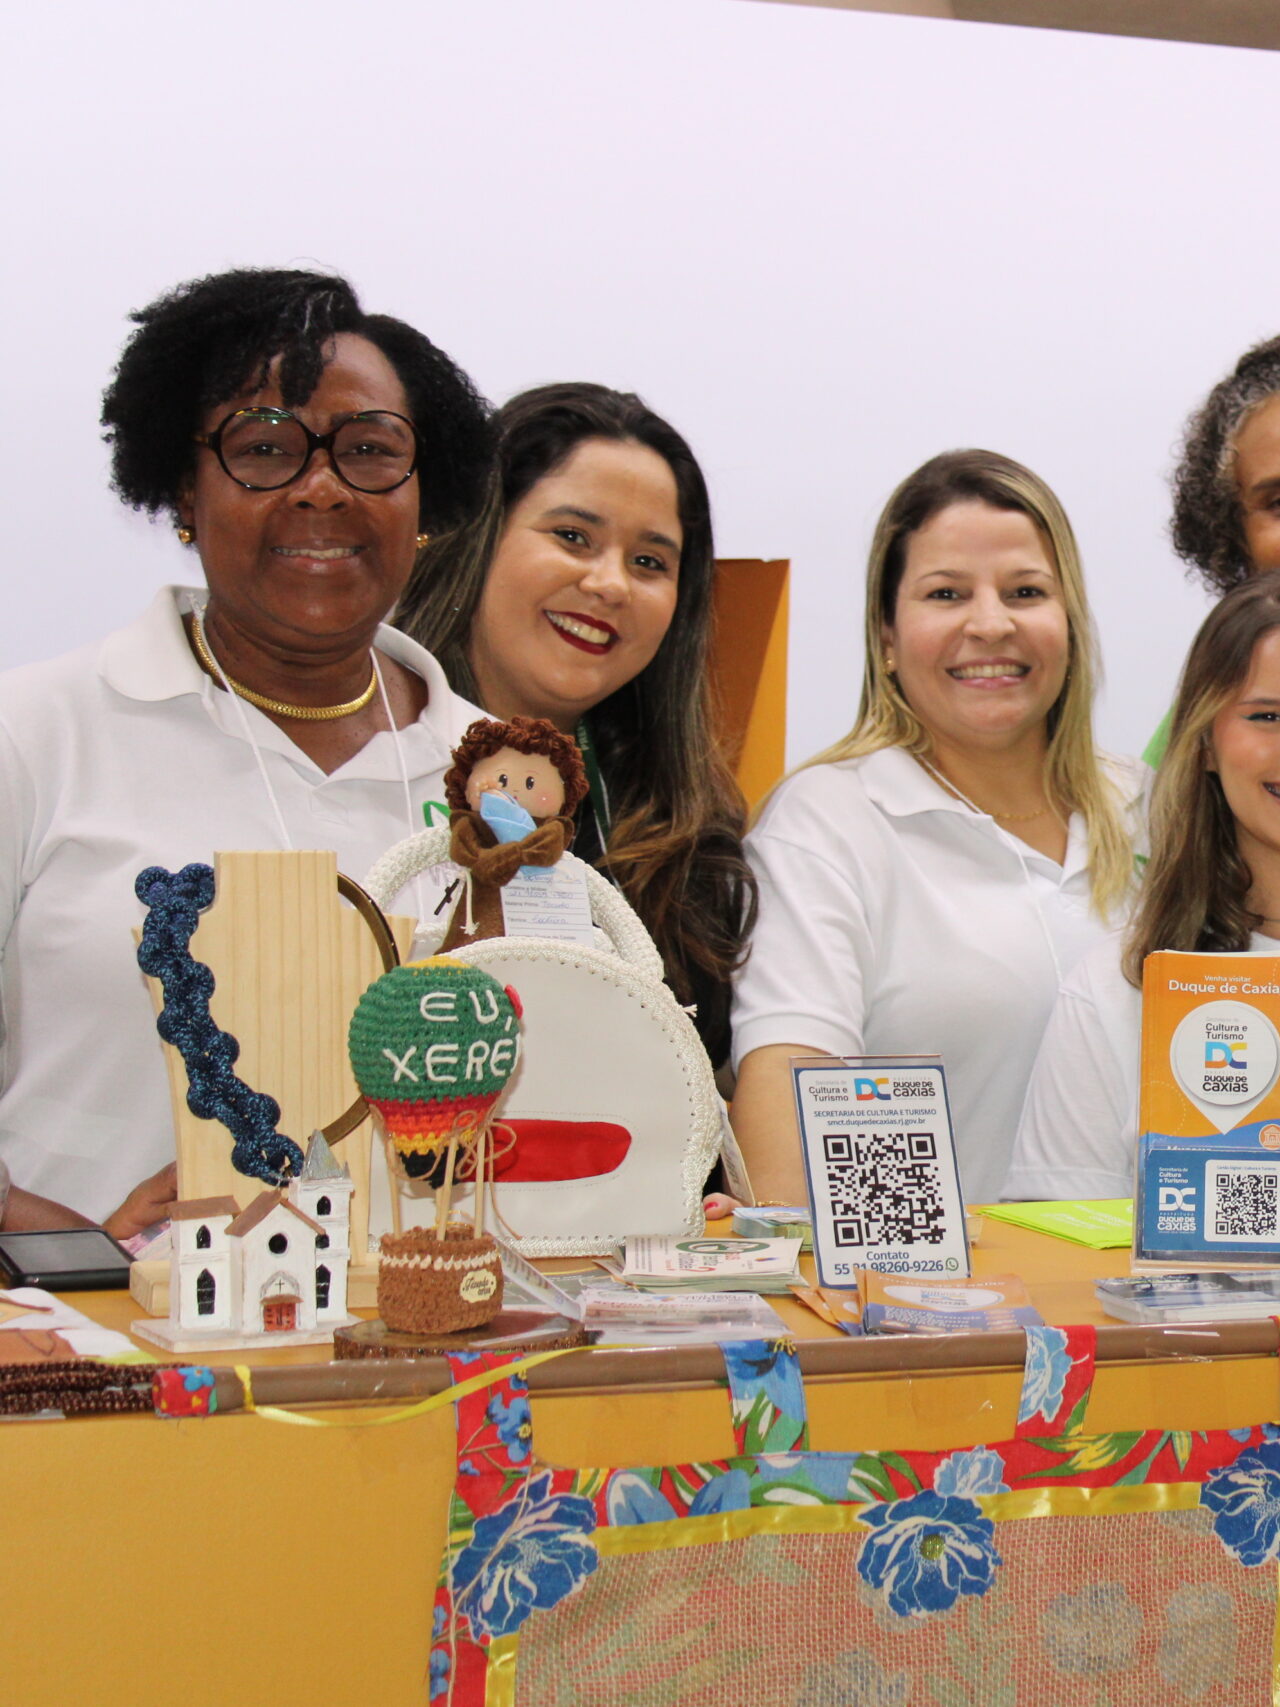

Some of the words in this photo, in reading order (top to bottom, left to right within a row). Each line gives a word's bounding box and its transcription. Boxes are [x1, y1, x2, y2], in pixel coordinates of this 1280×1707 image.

[1229, 975, 1252, 983] visitar
[1168, 979, 1216, 995] Duque
[1219, 982, 1238, 994] de
[420, 989, 499, 1025] EU
[1205, 1022, 1240, 1032] Cultura
[1241, 1024, 1248, 1032] e
[1205, 1031, 1244, 1040] Turismo
[383, 1016, 521, 1083] XERÉ
[808, 1086, 841, 1094] Cultura
[814, 1094, 849, 1102] Turismo
[813, 1110, 855, 1118] SECRETARIA
[866, 1109, 898, 1117] CULTURA
[906, 1108, 937, 1116] TURISMO
[866, 1250, 910, 1261] Contato
[834, 1263, 850, 1275] 55
[870, 1260, 944, 1274] 98260-9226
